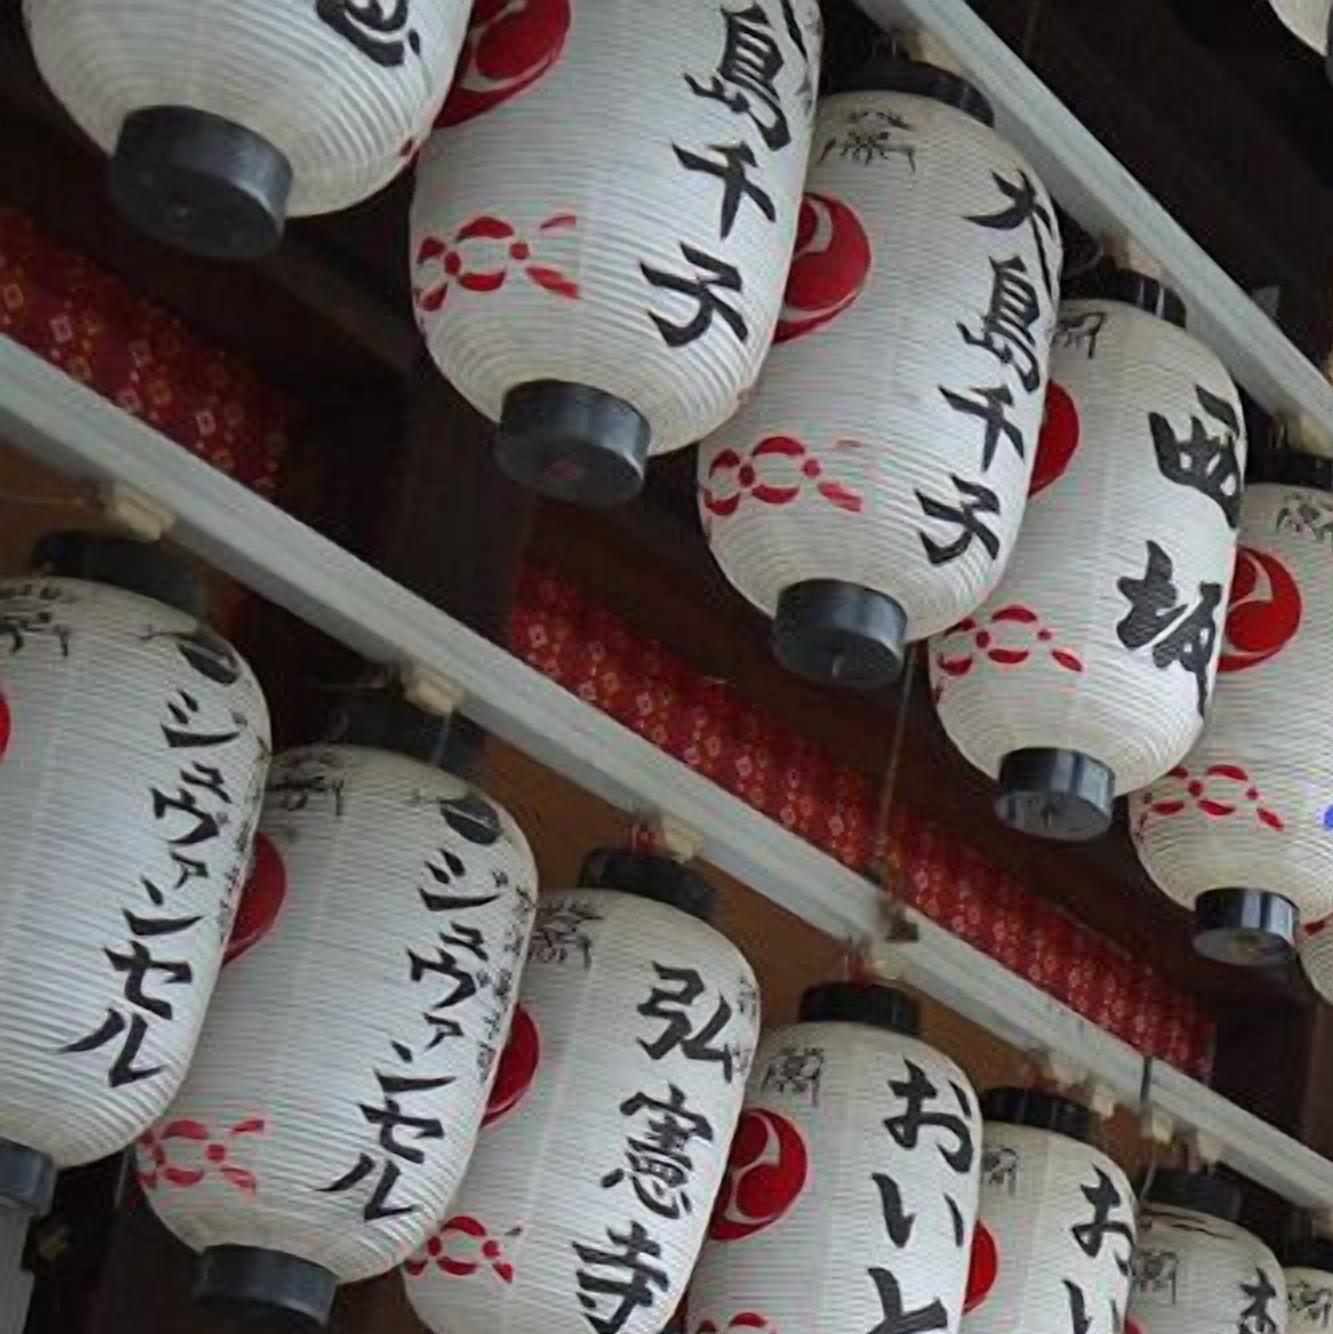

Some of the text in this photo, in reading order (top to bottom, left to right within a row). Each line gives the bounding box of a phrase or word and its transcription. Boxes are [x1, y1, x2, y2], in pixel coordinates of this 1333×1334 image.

[640, 0, 808, 346] 島千子
[58, 688, 247, 1088] ジュヴァンセル
[313, 848, 512, 1221] ジュヴァンセル
